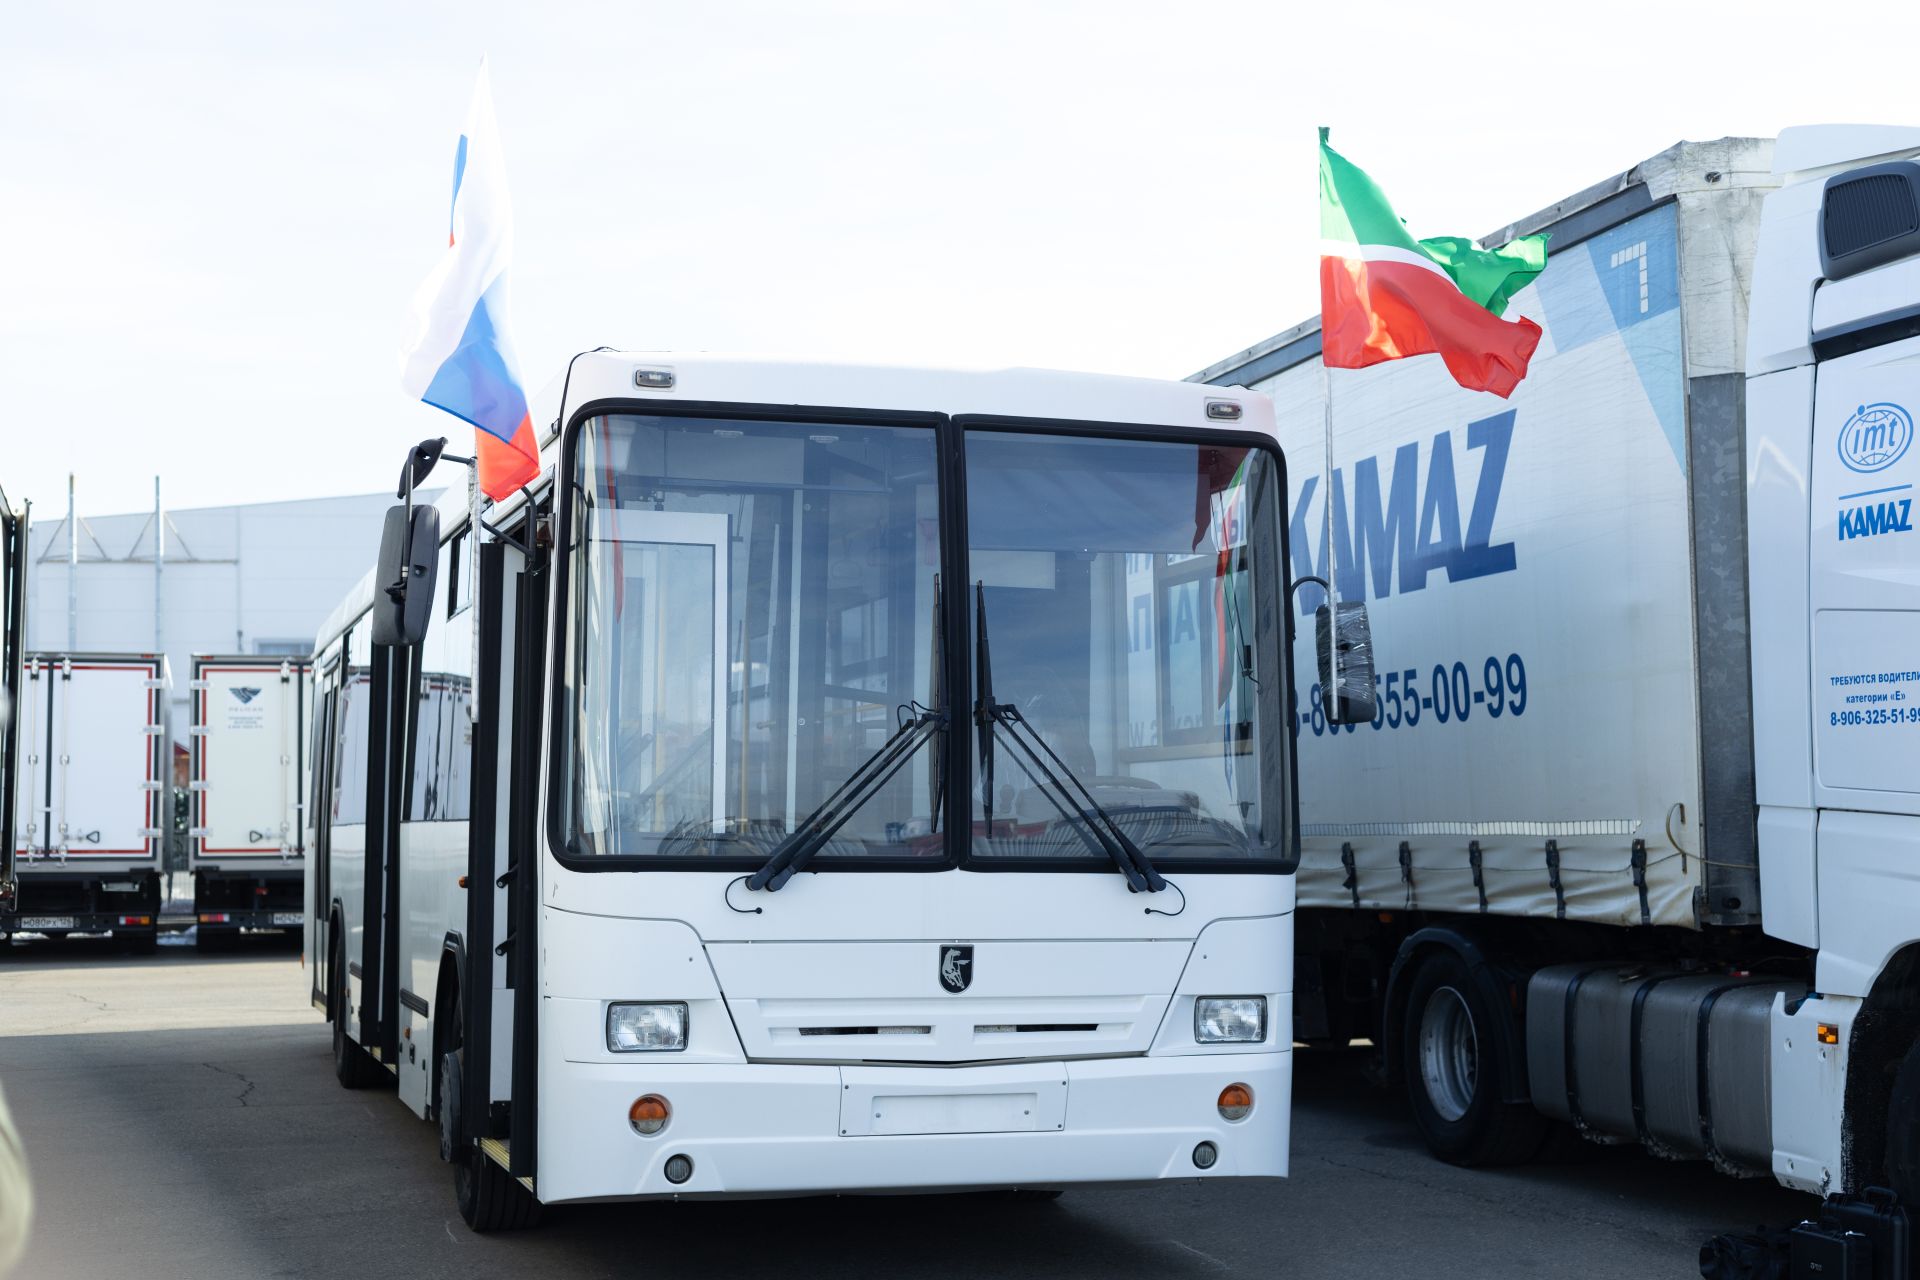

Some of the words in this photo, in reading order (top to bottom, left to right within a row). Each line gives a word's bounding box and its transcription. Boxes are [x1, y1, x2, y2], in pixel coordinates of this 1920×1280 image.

[1852, 405, 1898, 454] imt
[1289, 408, 1518, 617] KAMAZ
[1838, 499, 1913, 541] KAMAZ
[1830, 674, 1876, 685] ТРЕБУЮТСЯ
[1846, 693, 1888, 704] категории
[1830, 707, 1920, 726] 8-906-325-51-9
